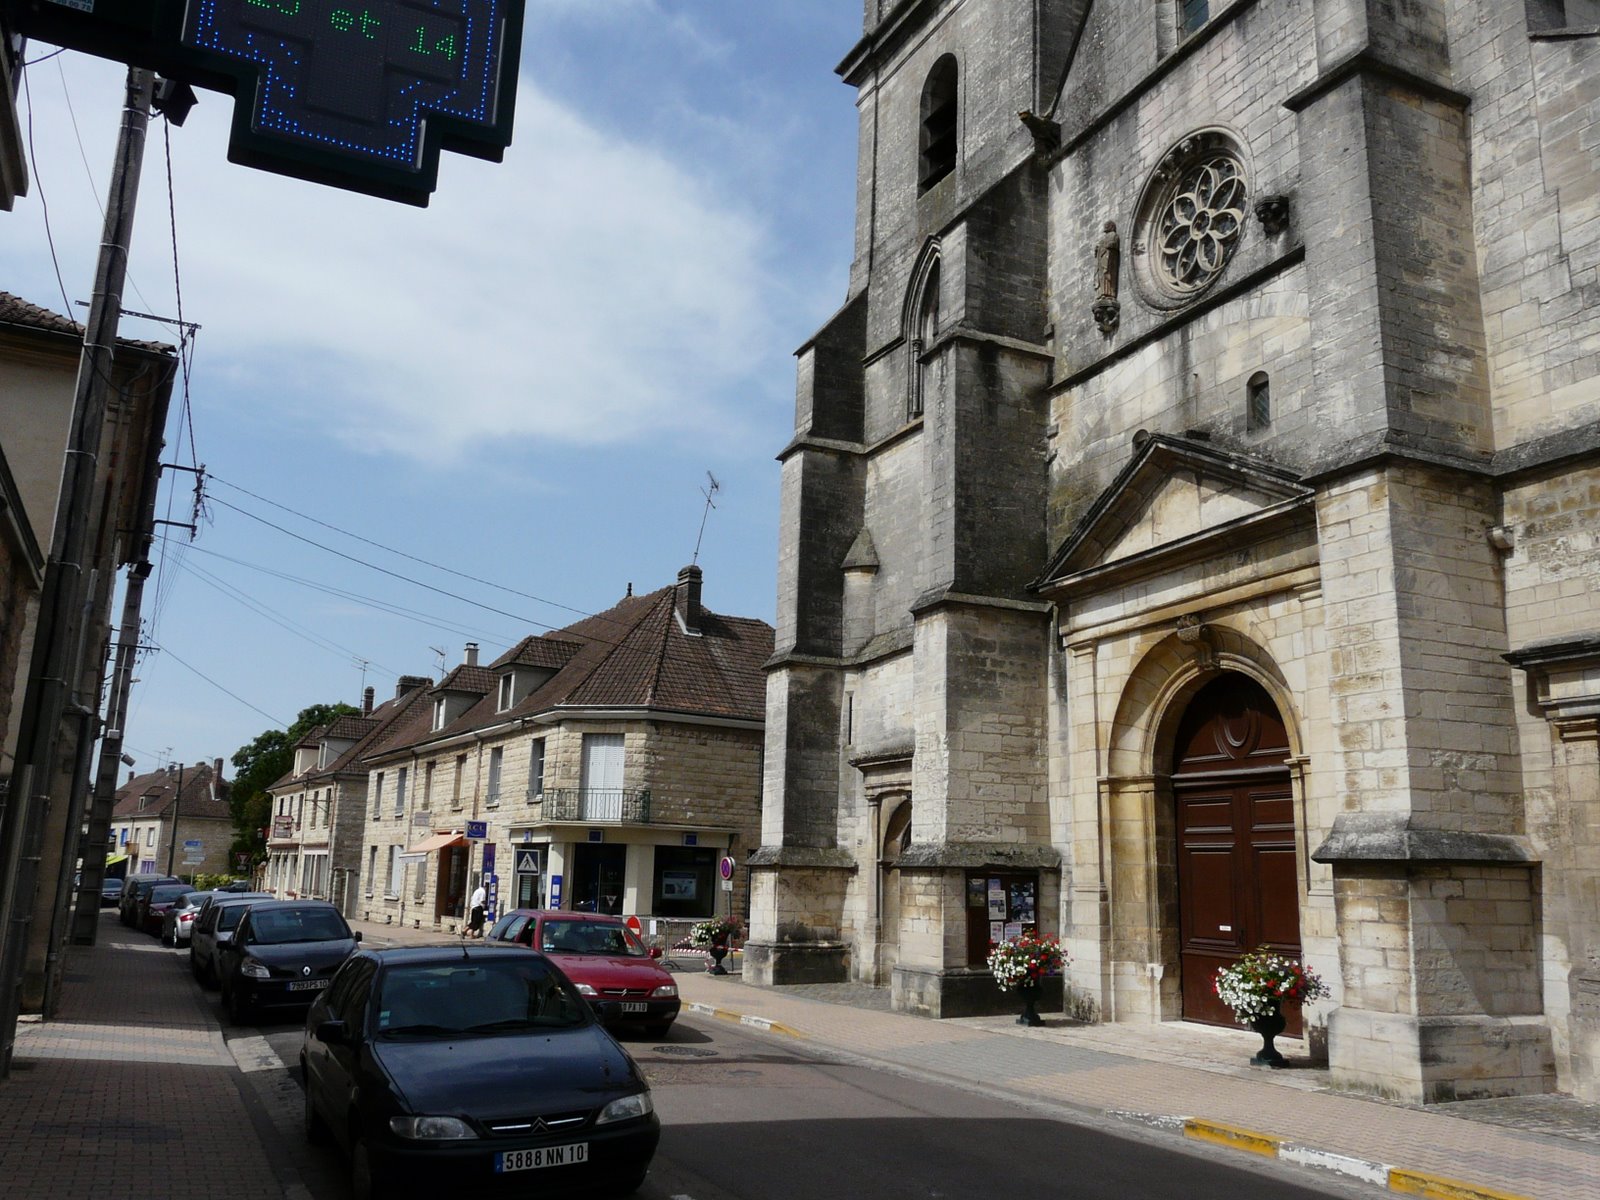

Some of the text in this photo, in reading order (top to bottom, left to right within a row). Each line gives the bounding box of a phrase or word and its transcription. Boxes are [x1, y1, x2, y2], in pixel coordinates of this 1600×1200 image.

[331, 10, 381, 39] et
[409, 26, 457, 61] 14
[506, 1144, 584, 1170] 5888 NN 10
